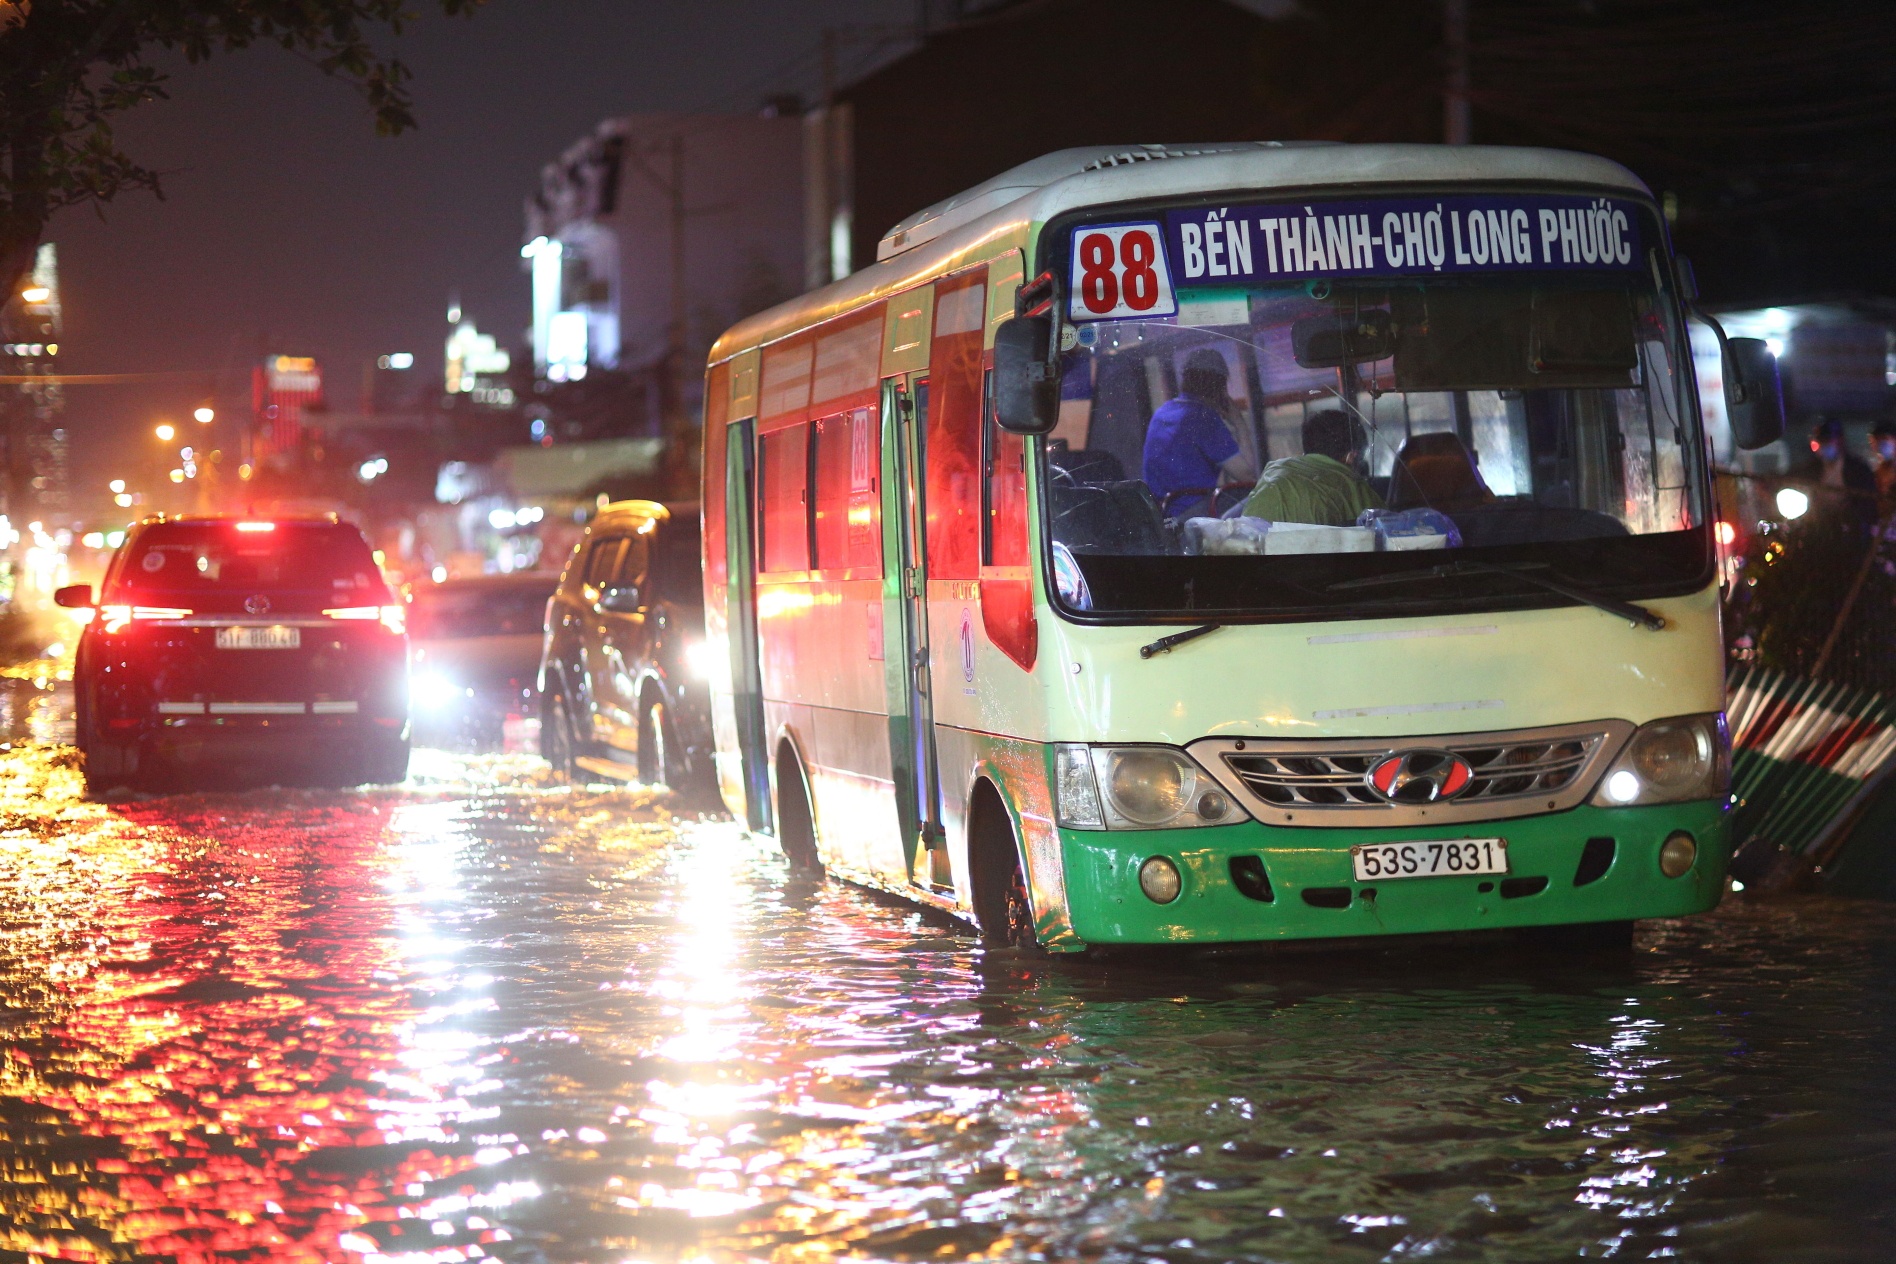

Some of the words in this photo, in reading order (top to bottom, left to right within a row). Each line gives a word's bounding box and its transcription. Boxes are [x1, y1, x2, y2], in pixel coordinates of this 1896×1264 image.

[1079, 229, 1159, 314] 88
[1180, 207, 1254, 278] BẾN
[1451, 208, 1533, 265] LONG
[1538, 198, 1631, 265] PHƯỚC
